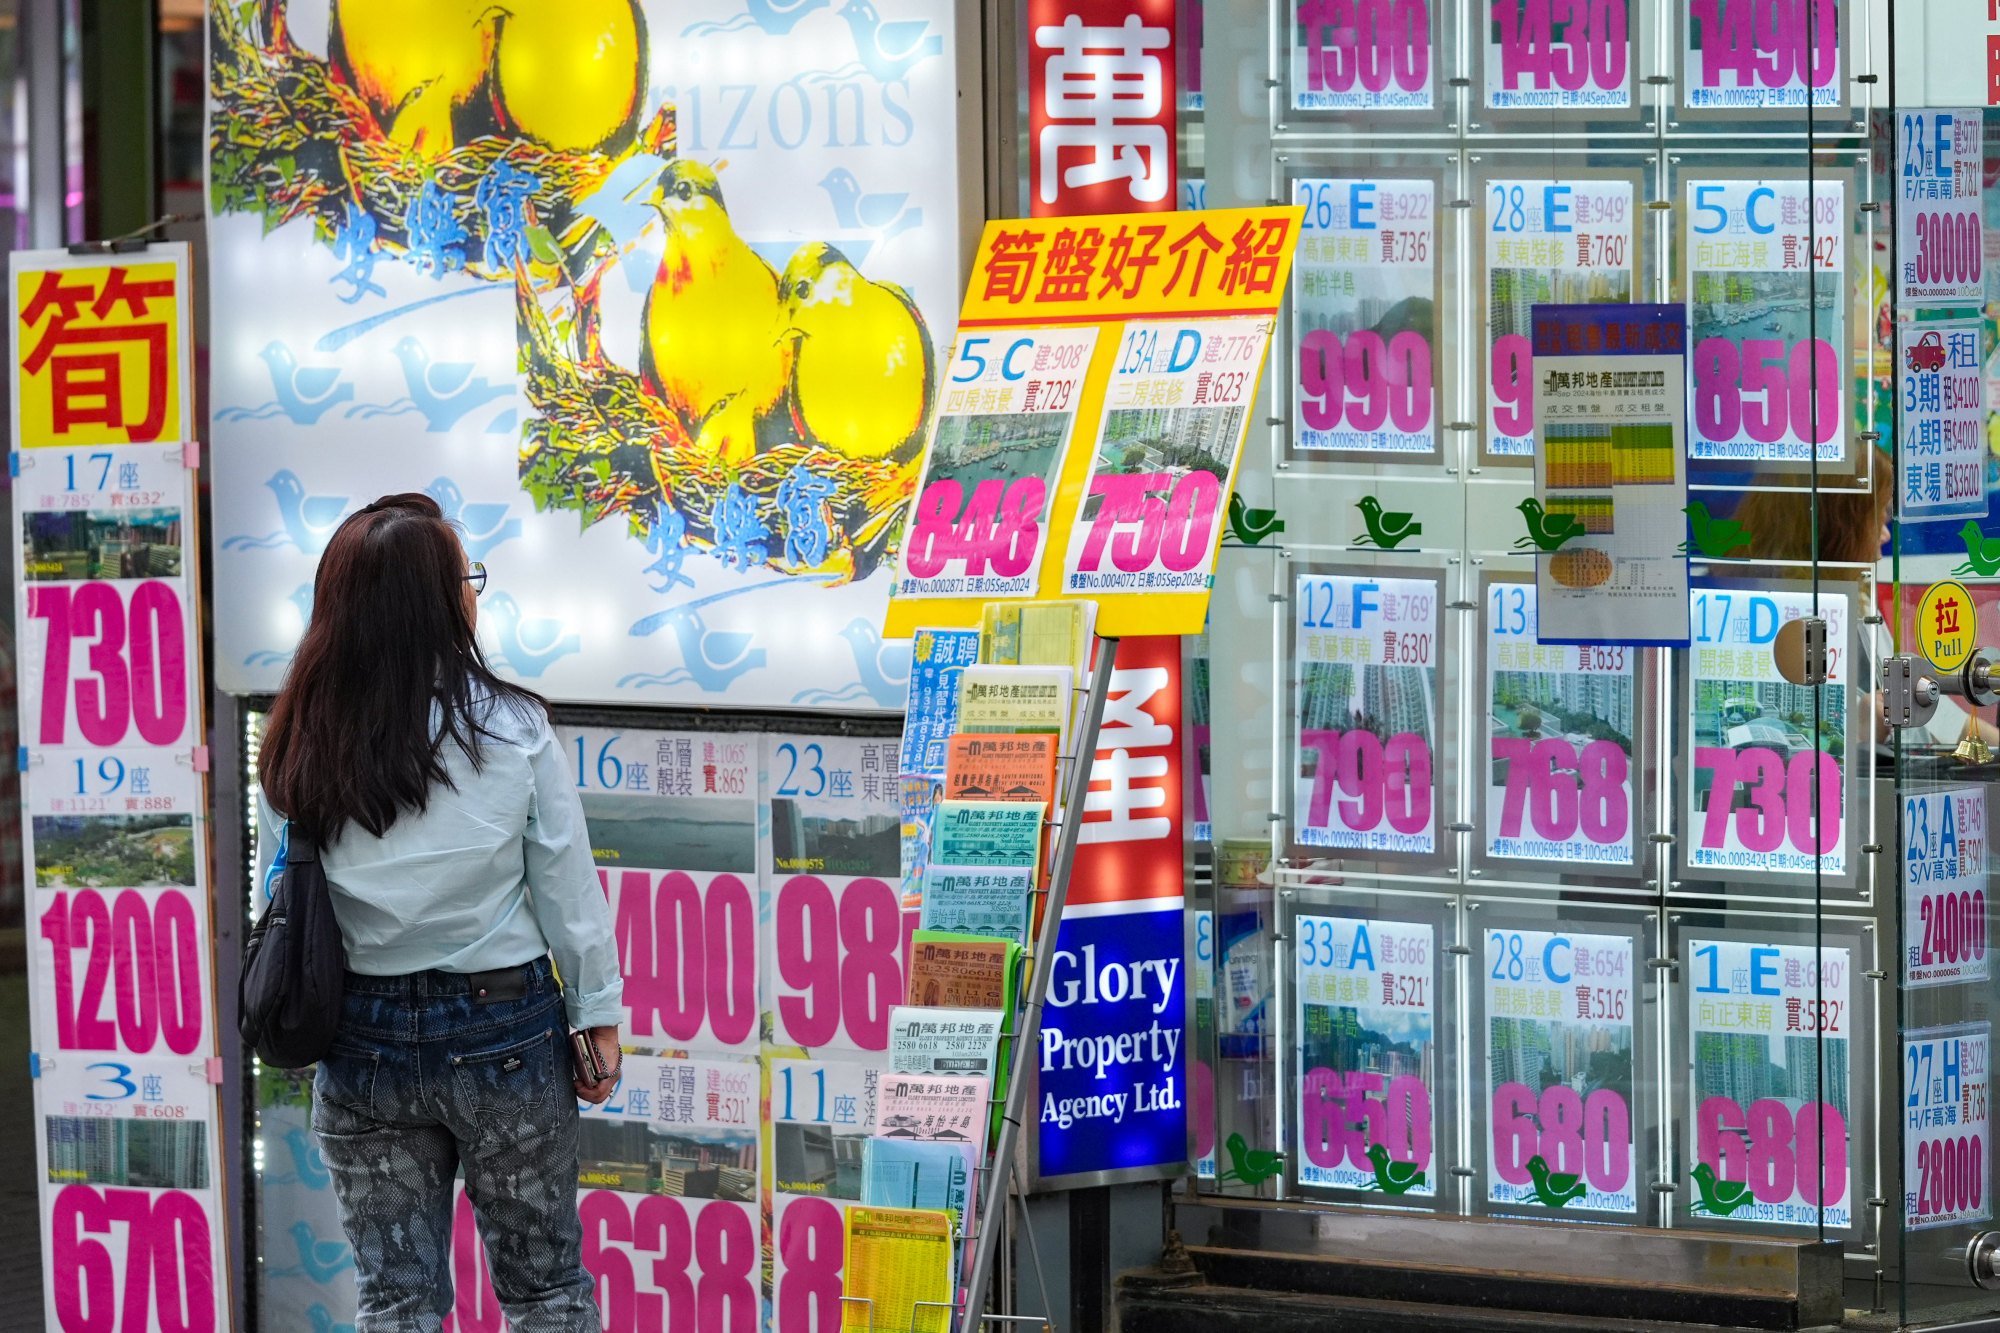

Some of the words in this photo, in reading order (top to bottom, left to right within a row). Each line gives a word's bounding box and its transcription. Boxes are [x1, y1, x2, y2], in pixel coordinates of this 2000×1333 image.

[1491, 0, 1626, 91] 1430
[1691, 0, 1836, 88] 1490
[1035, 14, 1170, 204] 萬
[983, 217, 1291, 304] 筍盤好介紹
[20, 266, 176, 443] 筍
[1300, 329, 1431, 433] 990
[1693, 337, 1839, 444] 850
[906, 477, 1047, 578] 848
[1076, 470, 1219, 573] 750
[26, 579, 186, 748] 730
[1934, 638, 1962, 658] Pull
[1935, 597, 1960, 635] 拉
[1301, 728, 1431, 834] 790
[1491, 737, 1629, 844] 768
[1695, 746, 1841, 855] 730
[41, 888, 203, 1055] 1200
[1046, 944, 1179, 1014] Glory
[1041, 1020, 1181, 1079] Property
[1040, 1092, 1128, 1129] Agency
[1133, 1077, 1182, 1113] Ltd.
[1303, 1066, 1432, 1173] 650
[1492, 1081, 1629, 1193] 680
[1697, 1095, 1846, 1207] 680
[52, 1183, 216, 1333] 670
